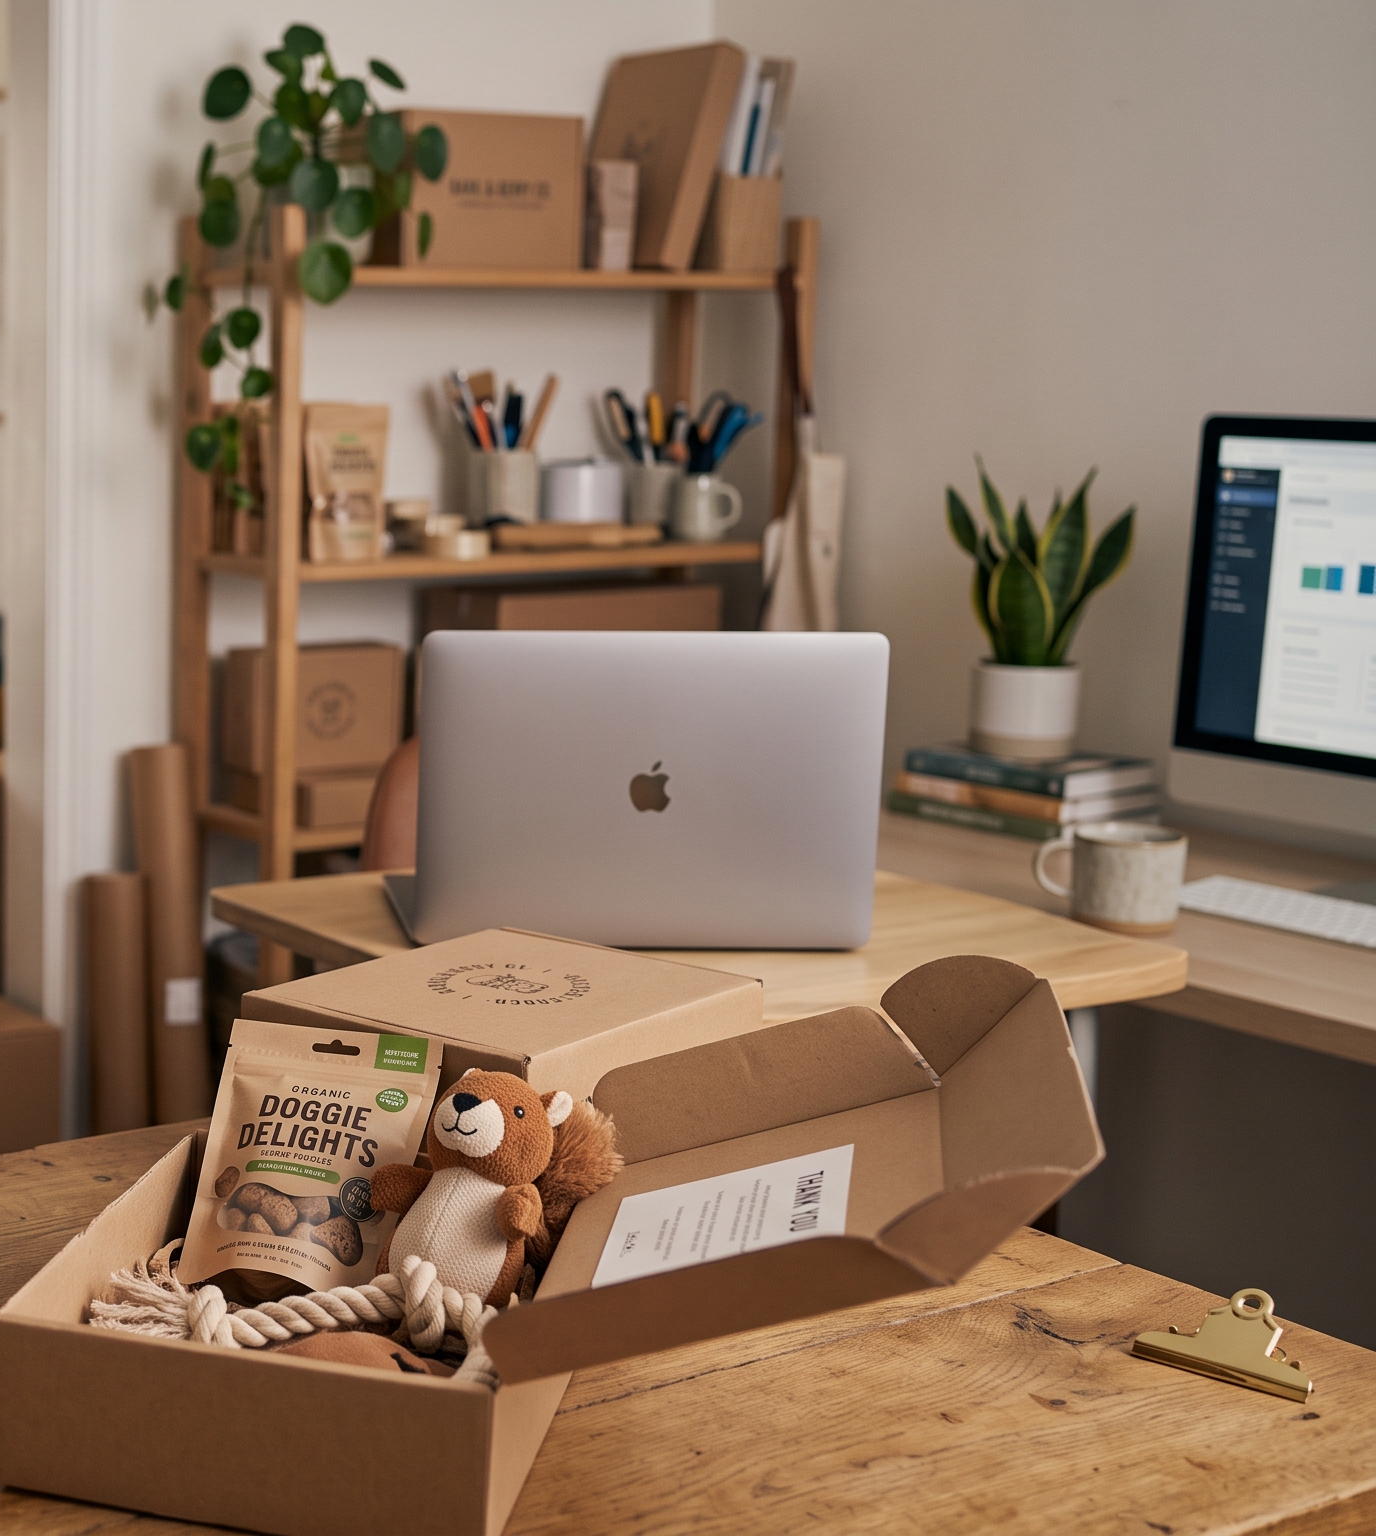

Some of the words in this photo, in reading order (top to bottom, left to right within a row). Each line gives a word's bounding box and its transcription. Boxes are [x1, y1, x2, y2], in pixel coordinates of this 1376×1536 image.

[258, 1094, 372, 1132] DOGGIE
[237, 1121, 379, 1168] DELIGHTS
[792, 1170, 825, 1209] THANK
[789, 1207, 819, 1233] YOU
